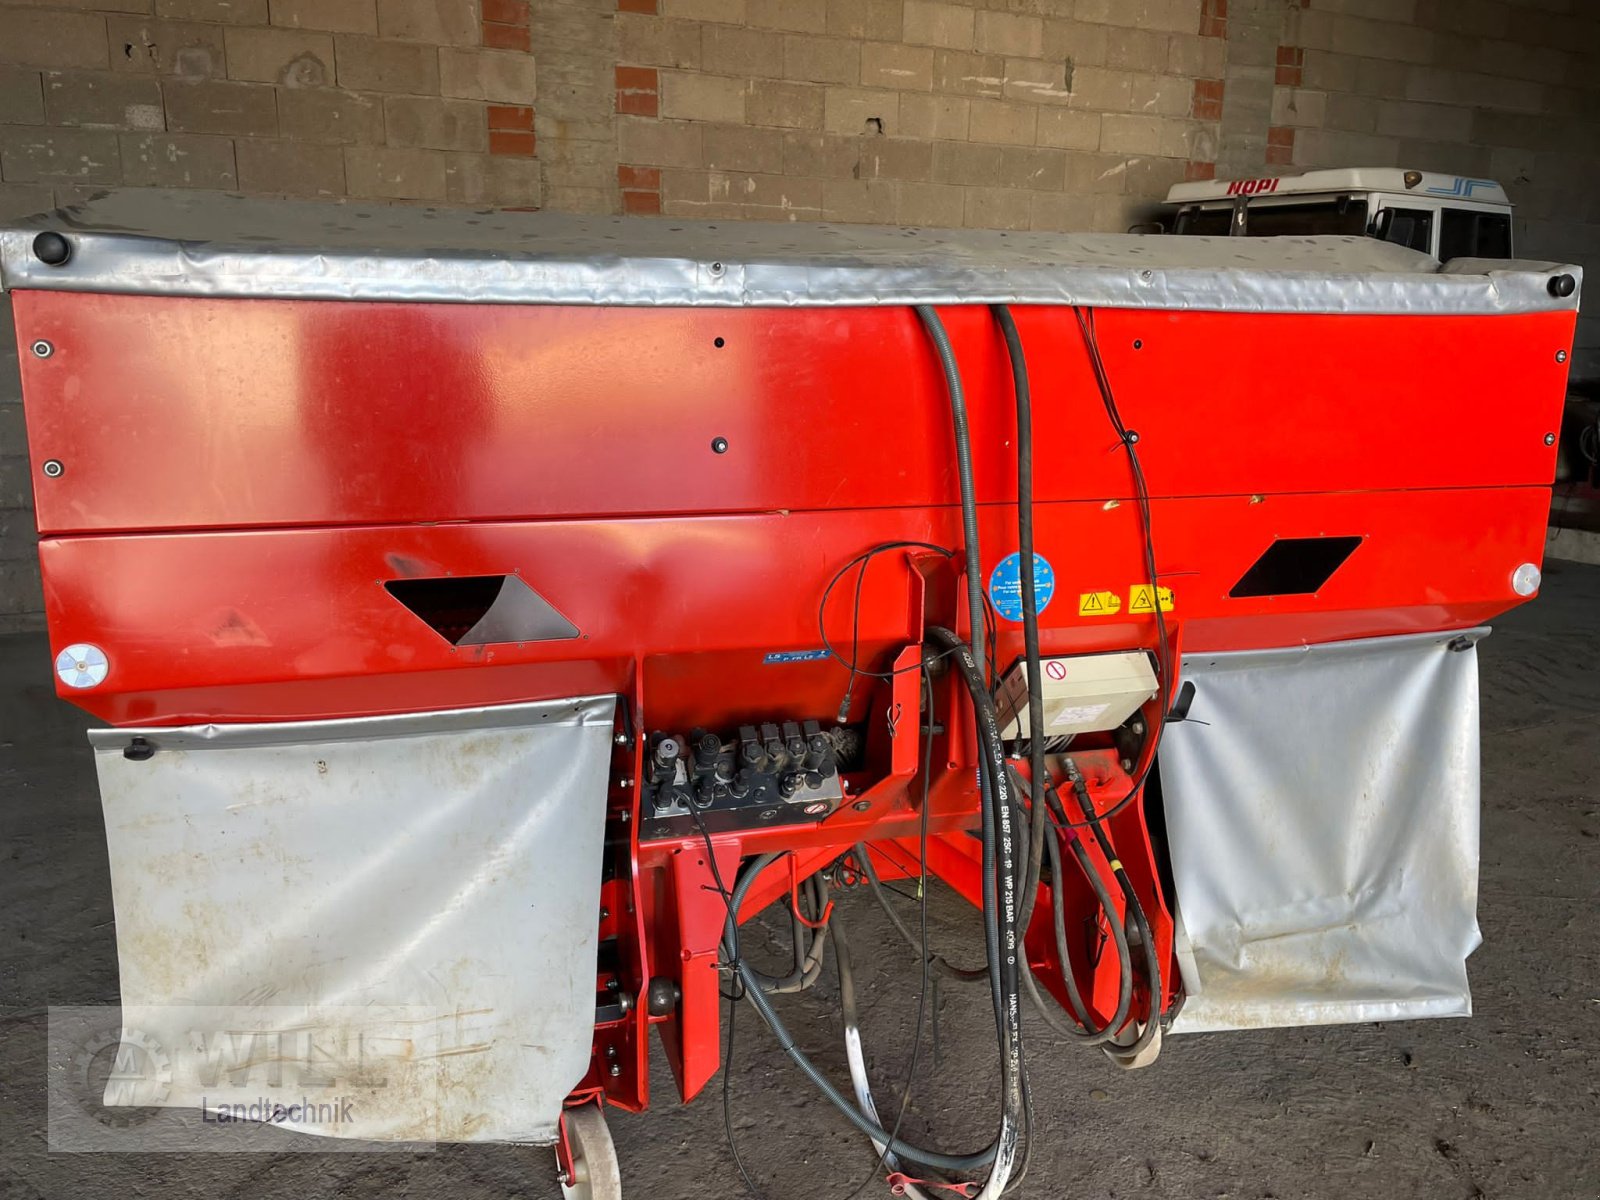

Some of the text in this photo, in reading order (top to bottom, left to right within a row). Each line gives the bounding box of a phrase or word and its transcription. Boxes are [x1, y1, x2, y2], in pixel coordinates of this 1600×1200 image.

[1227, 178, 1280, 195] NOPI
[998, 785, 1008, 800] 220
[1001, 805, 1010, 818] EN
[1002, 819, 1011, 834] 857
[1003, 837, 1012, 854] 2SC
[1004, 875, 1014, 890] WP
[1005, 890, 1014, 905] 215
[1005, 905, 1014, 923] BAR
